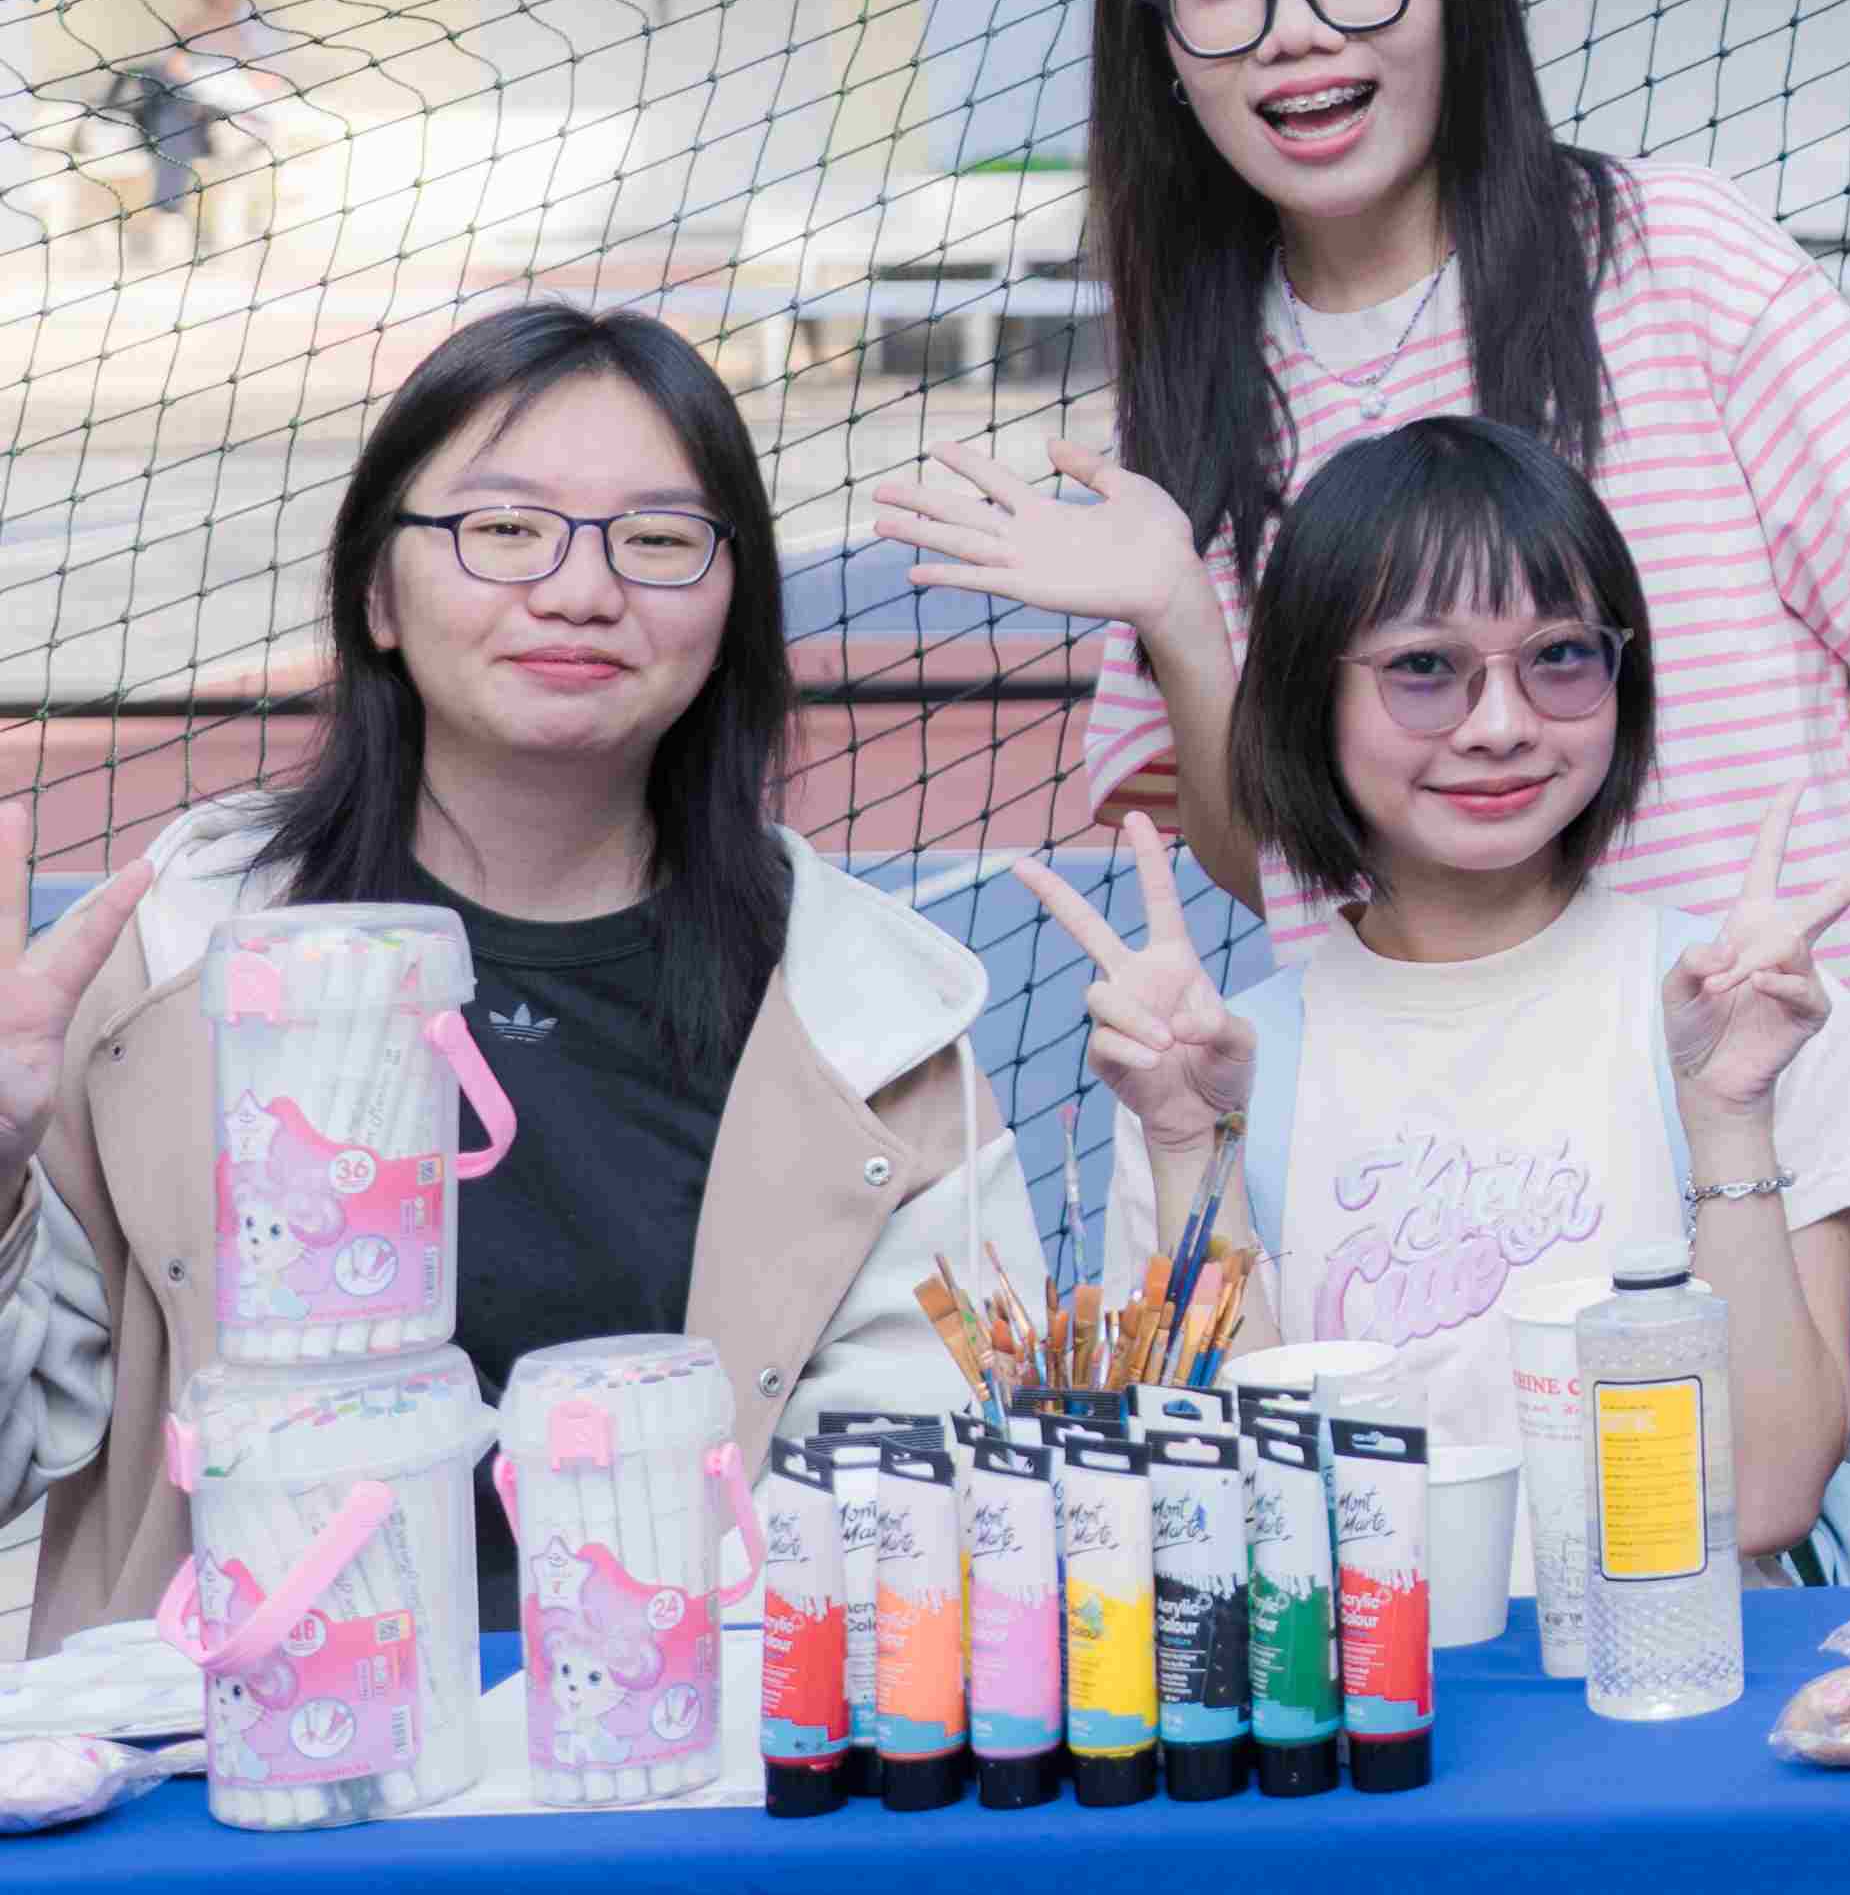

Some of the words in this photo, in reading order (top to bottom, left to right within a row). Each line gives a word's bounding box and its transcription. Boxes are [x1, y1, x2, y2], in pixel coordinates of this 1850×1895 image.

[336, 1159, 370, 1181] 36
[1339, 1489, 1378, 1513] Mont
[653, 1595, 680, 1619] 24
